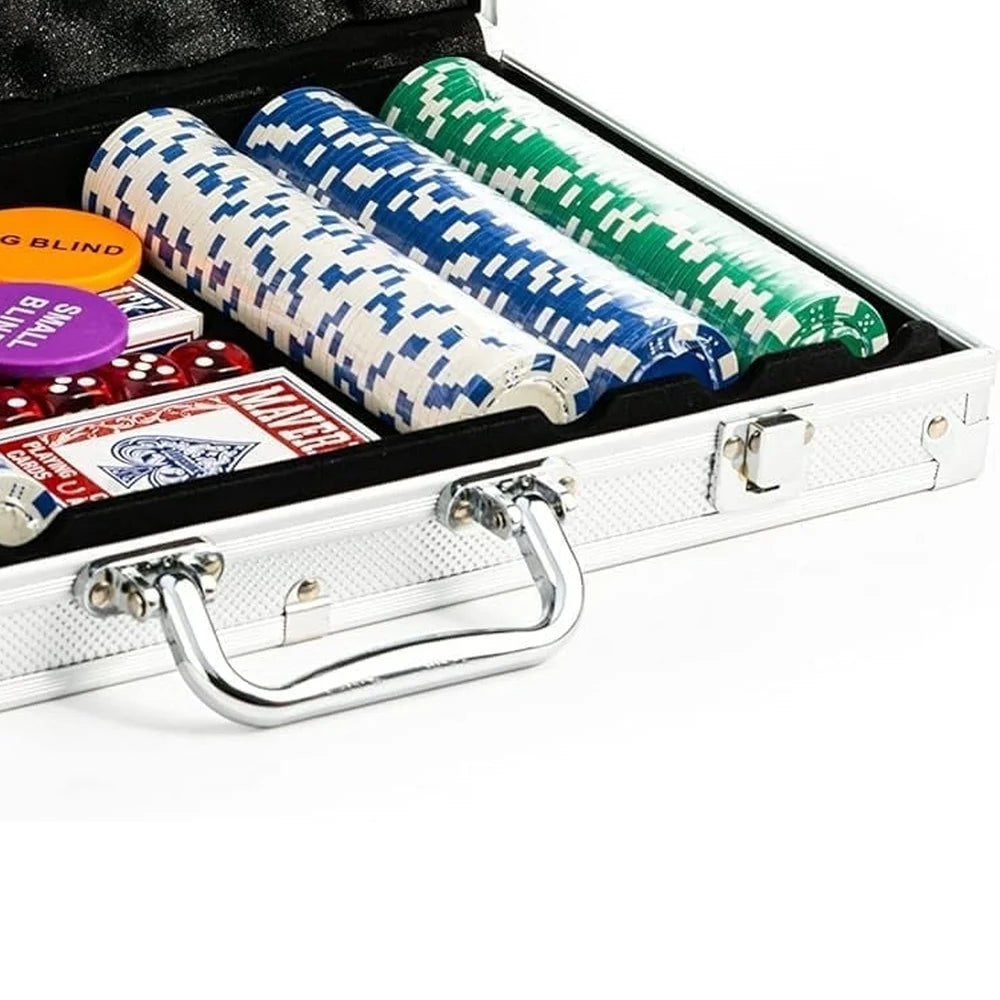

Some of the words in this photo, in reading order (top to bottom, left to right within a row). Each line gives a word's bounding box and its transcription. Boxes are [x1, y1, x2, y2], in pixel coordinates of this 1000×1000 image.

[30, 238, 124, 255] BLIND
[6, 303, 82, 348] SMALL
[229, 385, 360, 455] MAVER
[6, 449, 53, 480] CARDS
[22, 440, 78, 479] PLAYING
